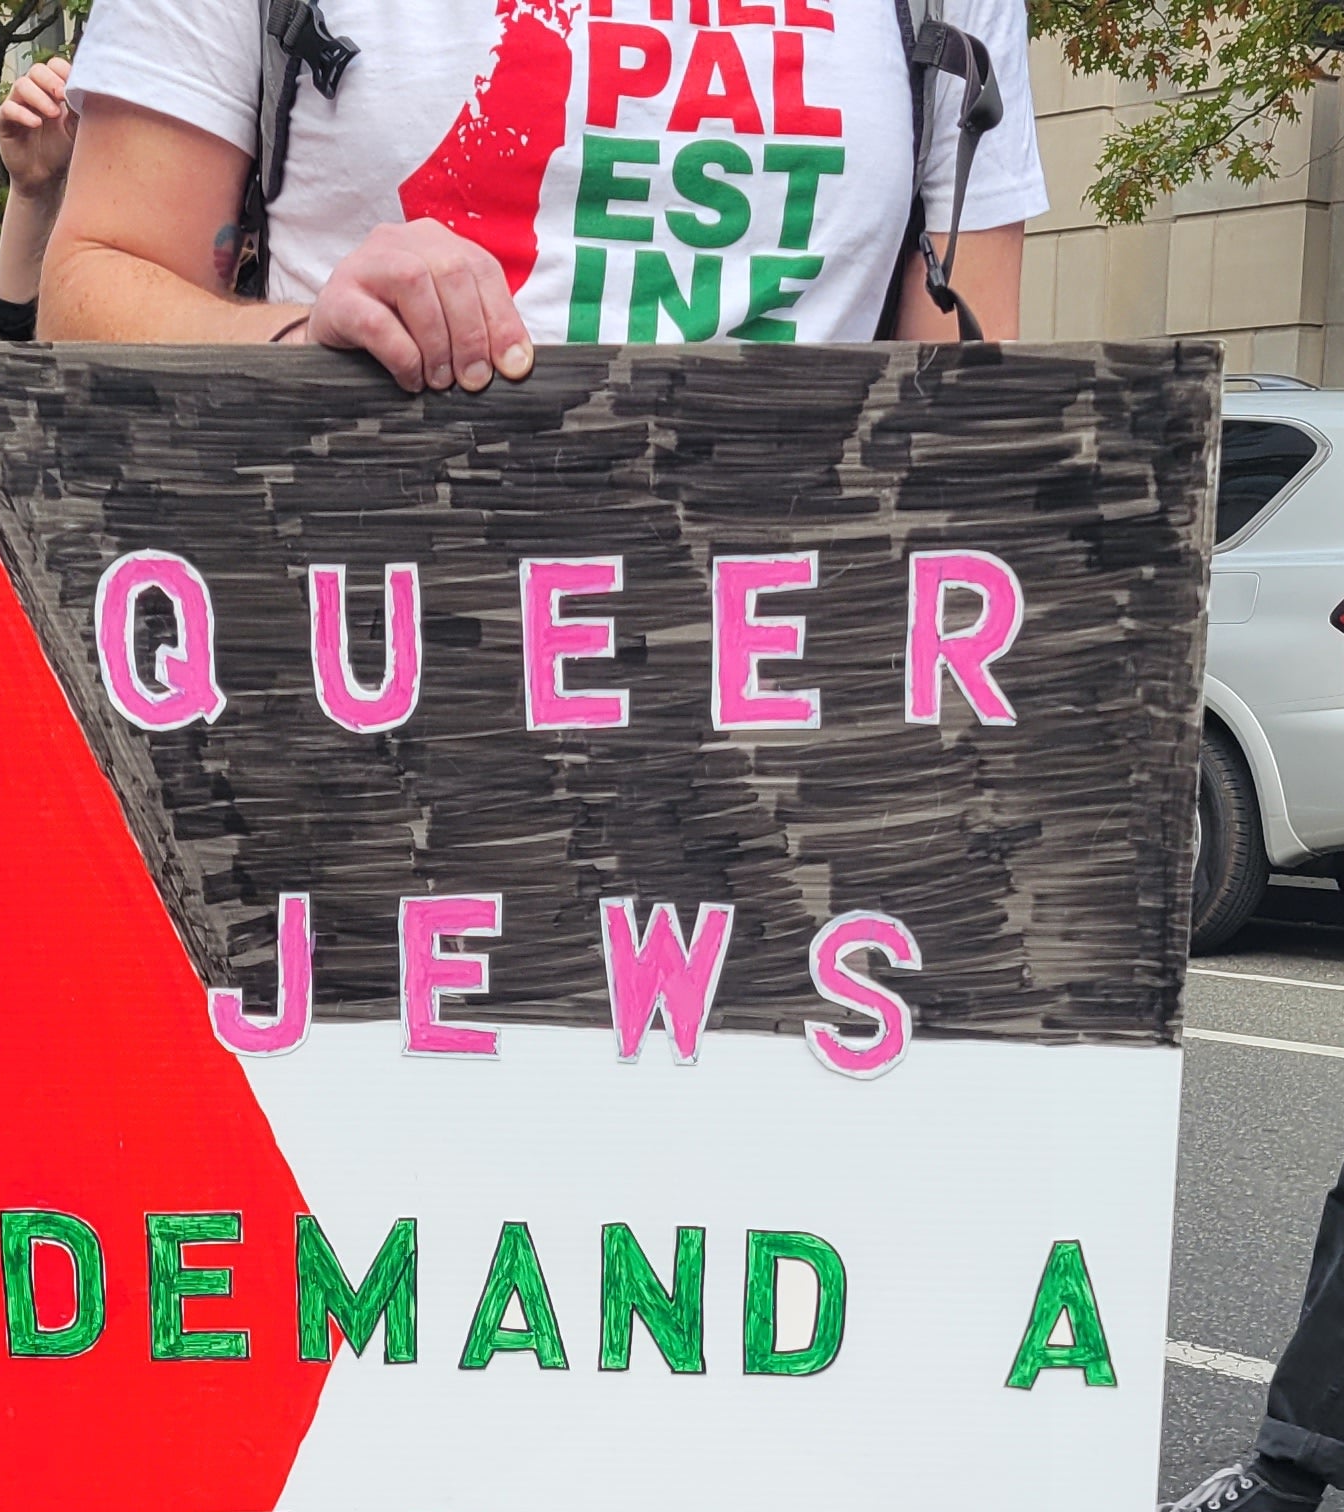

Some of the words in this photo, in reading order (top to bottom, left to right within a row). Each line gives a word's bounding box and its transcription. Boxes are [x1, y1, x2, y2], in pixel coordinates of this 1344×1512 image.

[585, 21, 843, 138] PAL
[573, 133, 846, 251] EST
[566, 244, 826, 344] INE
[94, 547, 1025, 734] QUEER
[207, 891, 924, 1081] JEWS
[1003, 1238, 1119, 1391] A
